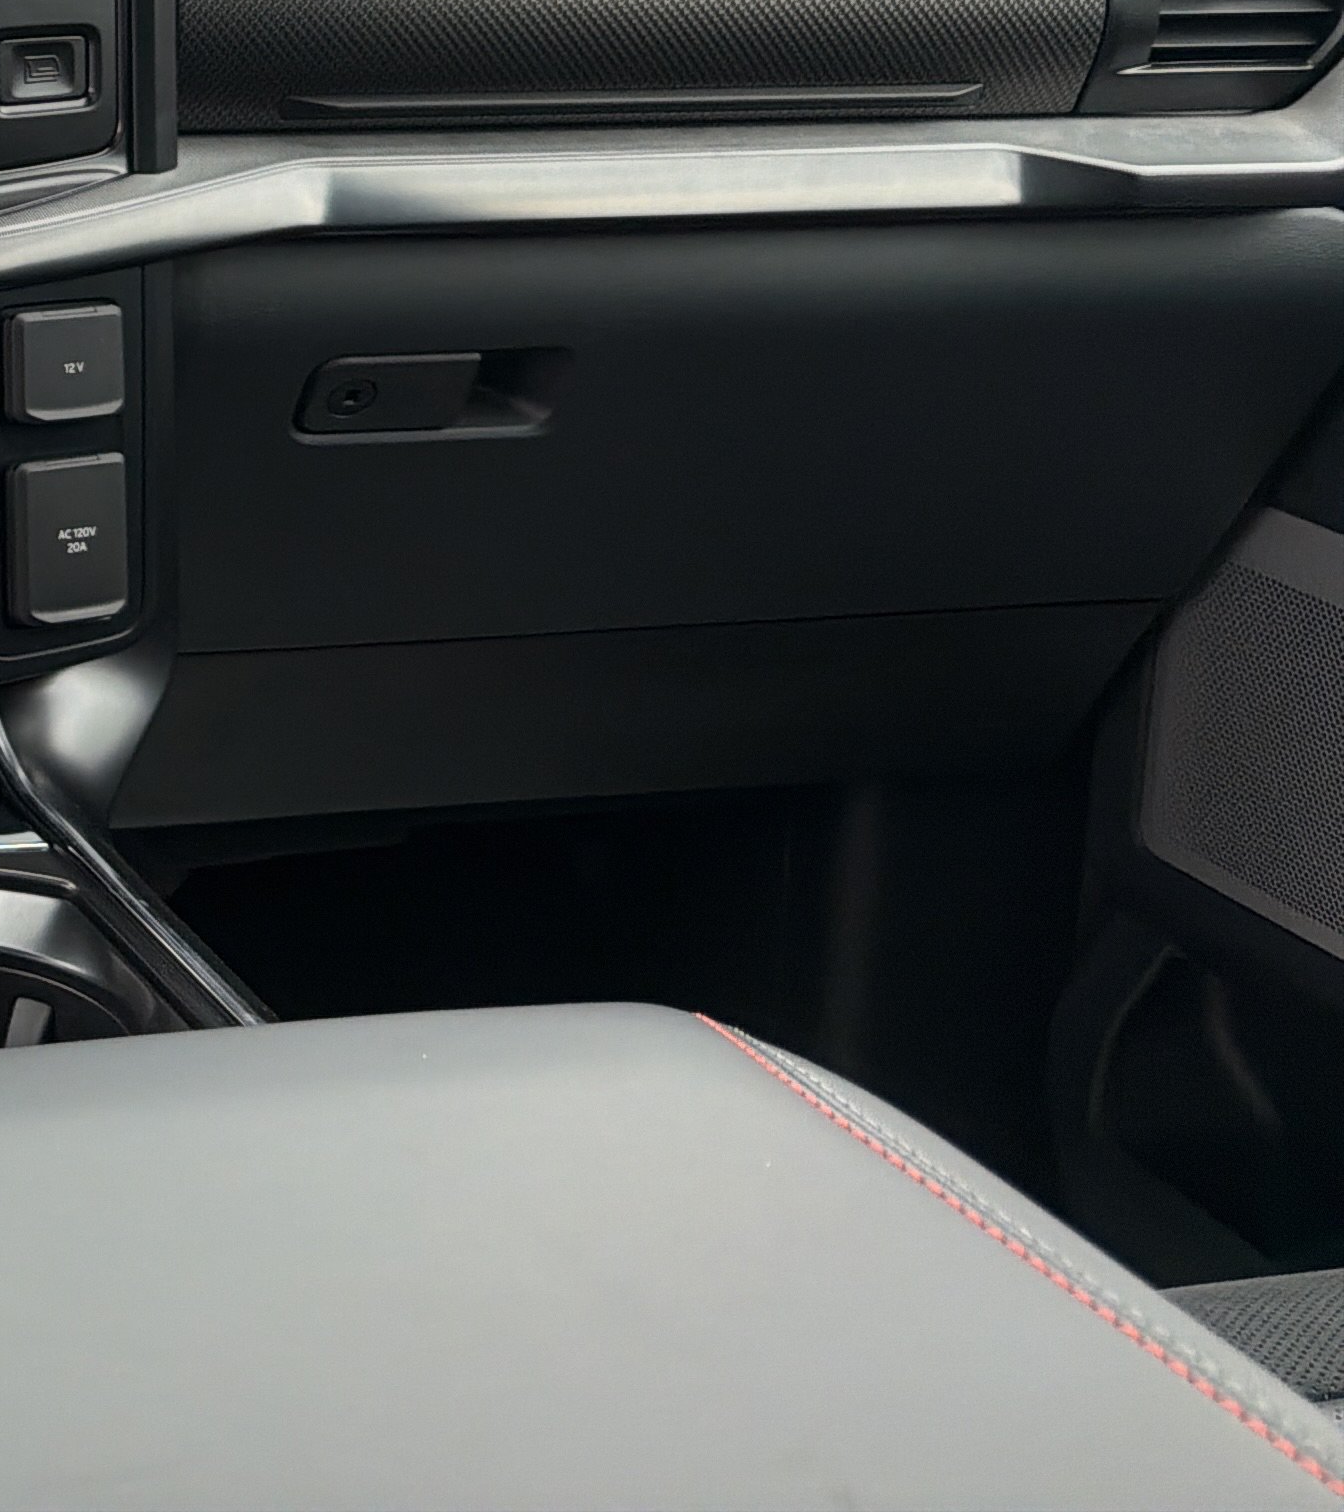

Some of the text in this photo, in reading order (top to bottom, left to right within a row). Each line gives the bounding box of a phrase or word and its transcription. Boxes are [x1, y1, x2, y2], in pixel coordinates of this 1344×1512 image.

[58, 526, 97, 540] AC 120V
[67, 542, 88, 554] 20A
